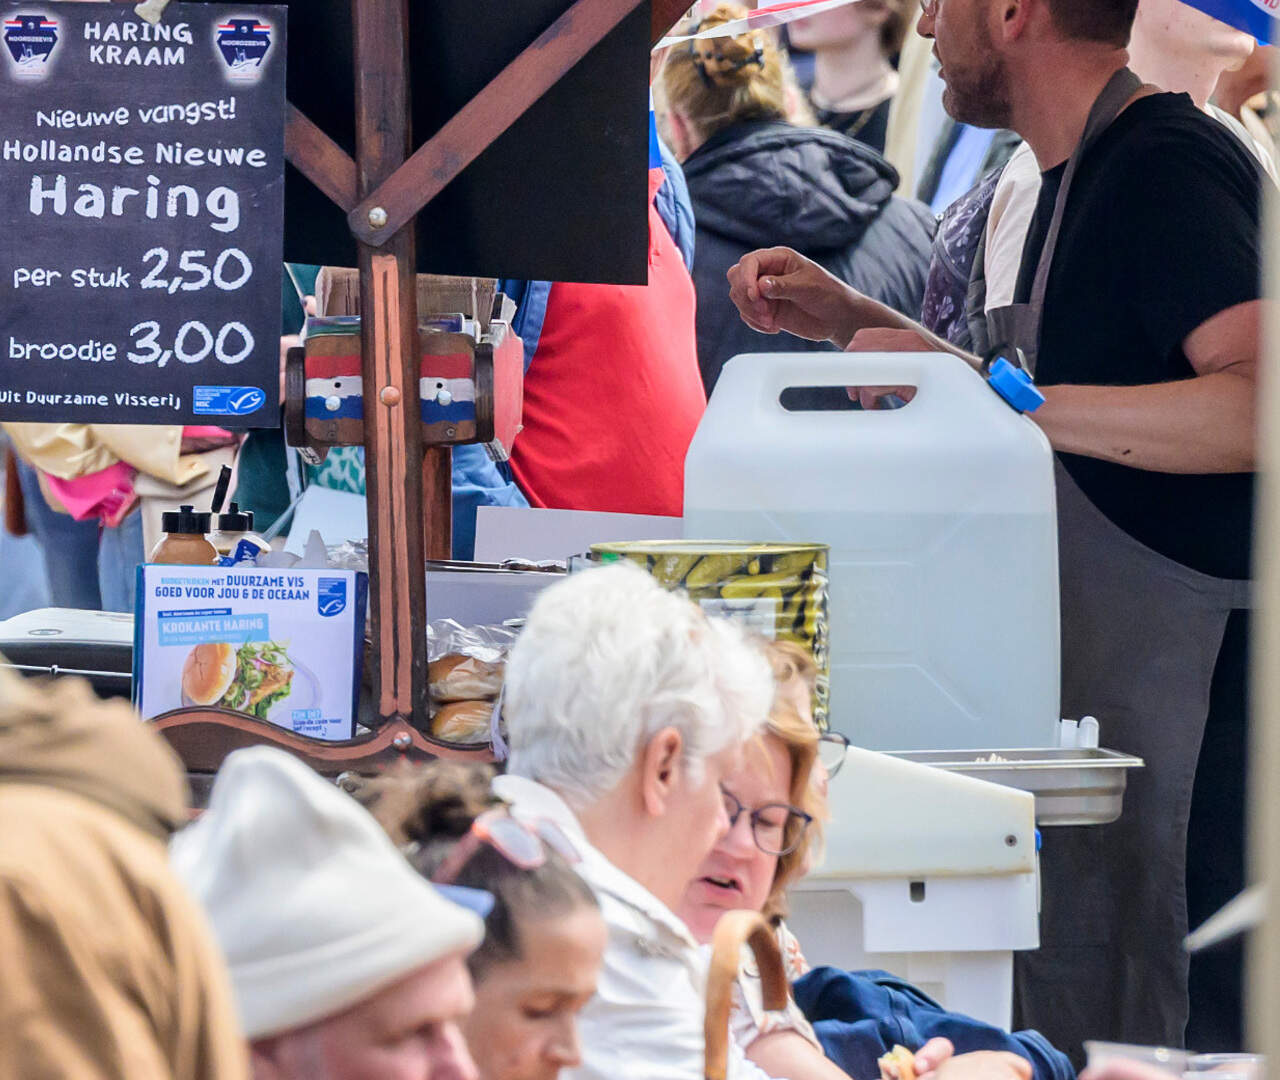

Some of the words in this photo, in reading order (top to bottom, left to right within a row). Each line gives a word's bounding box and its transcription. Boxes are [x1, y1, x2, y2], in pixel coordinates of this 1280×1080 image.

[83, 21, 194, 45] HARING
[90, 45, 185, 66] KRAAM
[36, 106, 129, 128] Nieuwe
[139, 97, 236, 125] vangst!
[3, 140, 144, 165] Hollandse
[156, 142, 267, 167] Nieuwe
[29, 174, 240, 232] Haring
[13, 267, 61, 288] per
[71, 266, 130, 288] stuk
[140, 247, 253, 294] 2,50
[9, 337, 117, 362] broodje
[126, 320, 255, 368] 3,00
[26, 391, 109, 406] Duurzame
[114, 392, 181, 410] Visserij
[155, 586, 182, 598] GOED
[186, 587, 215, 599] VOOR
[218, 588, 239, 599] JOU
[243, 588, 249, 599] &
[252, 589, 264, 600] DE
[268, 589, 310, 600] OCEAAN
[212, 578, 224, 586] MET
[227, 575, 284, 587] DUURZAME
[287, 576, 304, 588] VIS
[162, 621, 221, 634] KROKANTE
[224, 617, 264, 631] HARING
